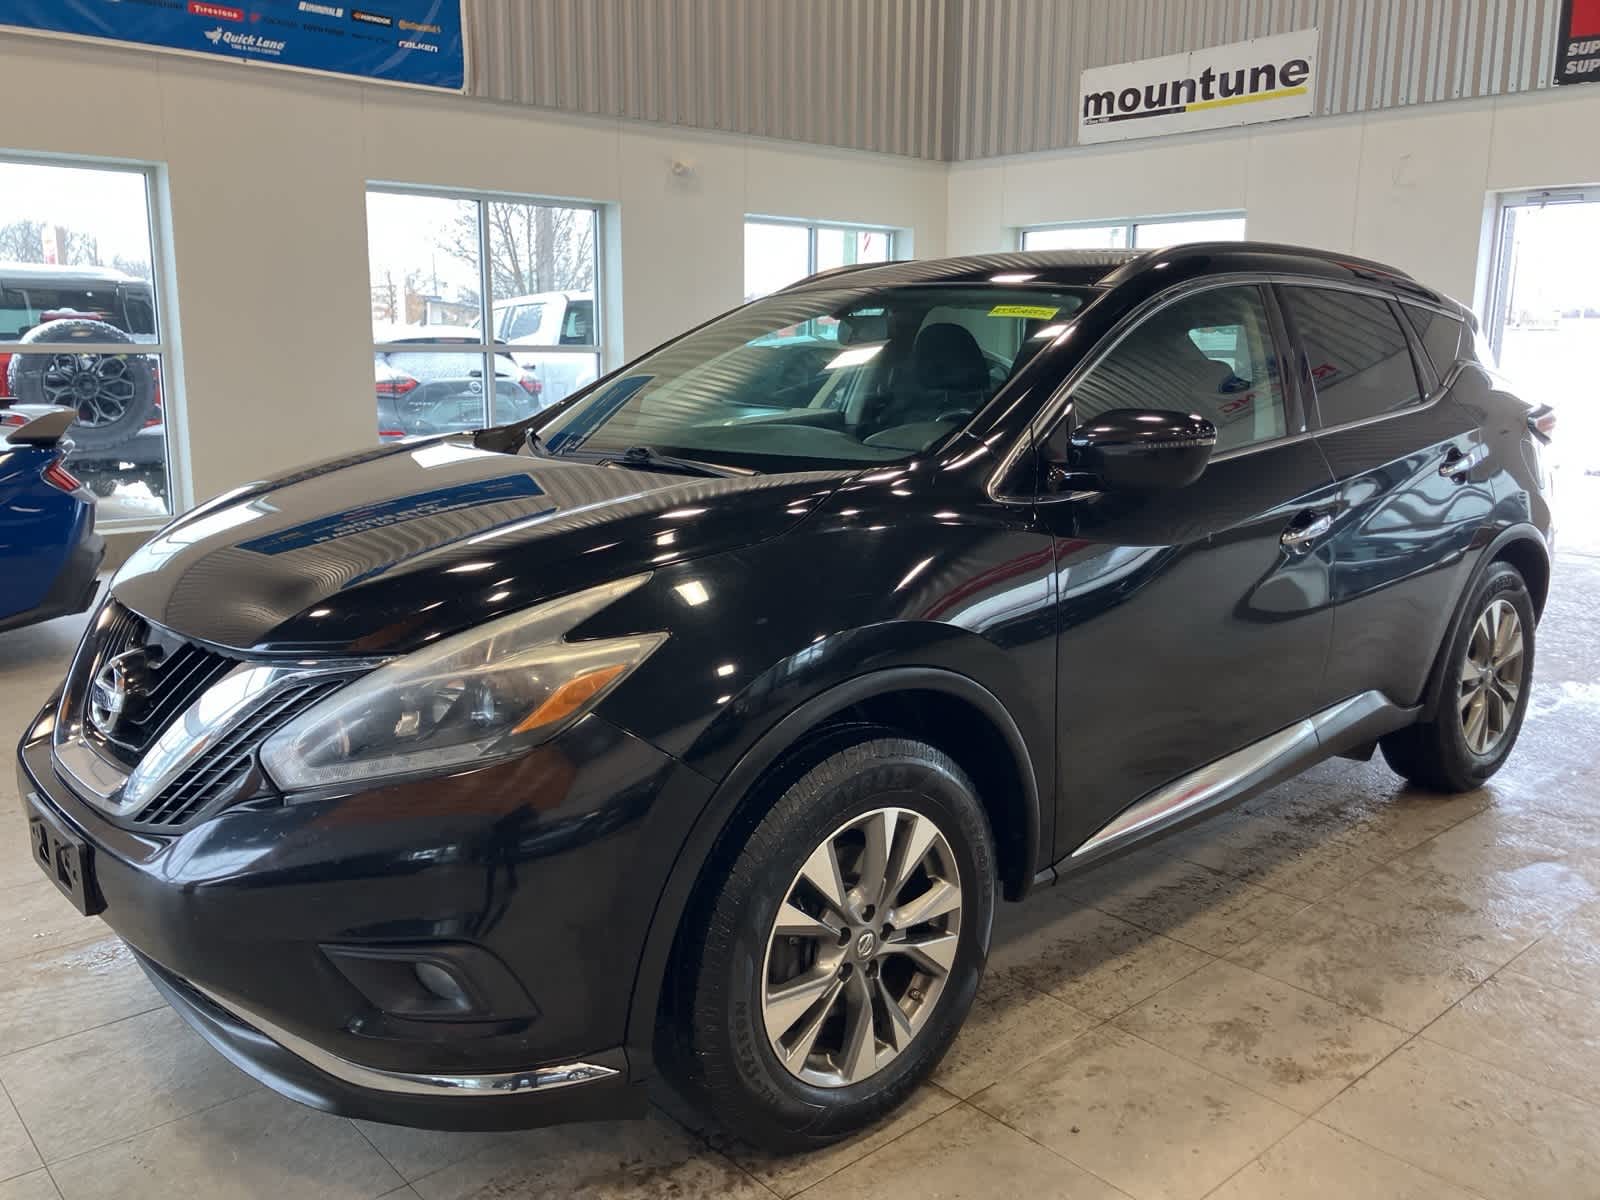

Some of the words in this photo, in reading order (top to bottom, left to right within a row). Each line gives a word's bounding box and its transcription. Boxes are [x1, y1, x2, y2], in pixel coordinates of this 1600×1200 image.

[194, 4, 239, 18] Firestone
[223, 31, 256, 46] Quick
[255, 36, 285, 50] Lane
[398, 40, 439, 53] FALKEN
[1083, 58, 1310, 118] mountune
